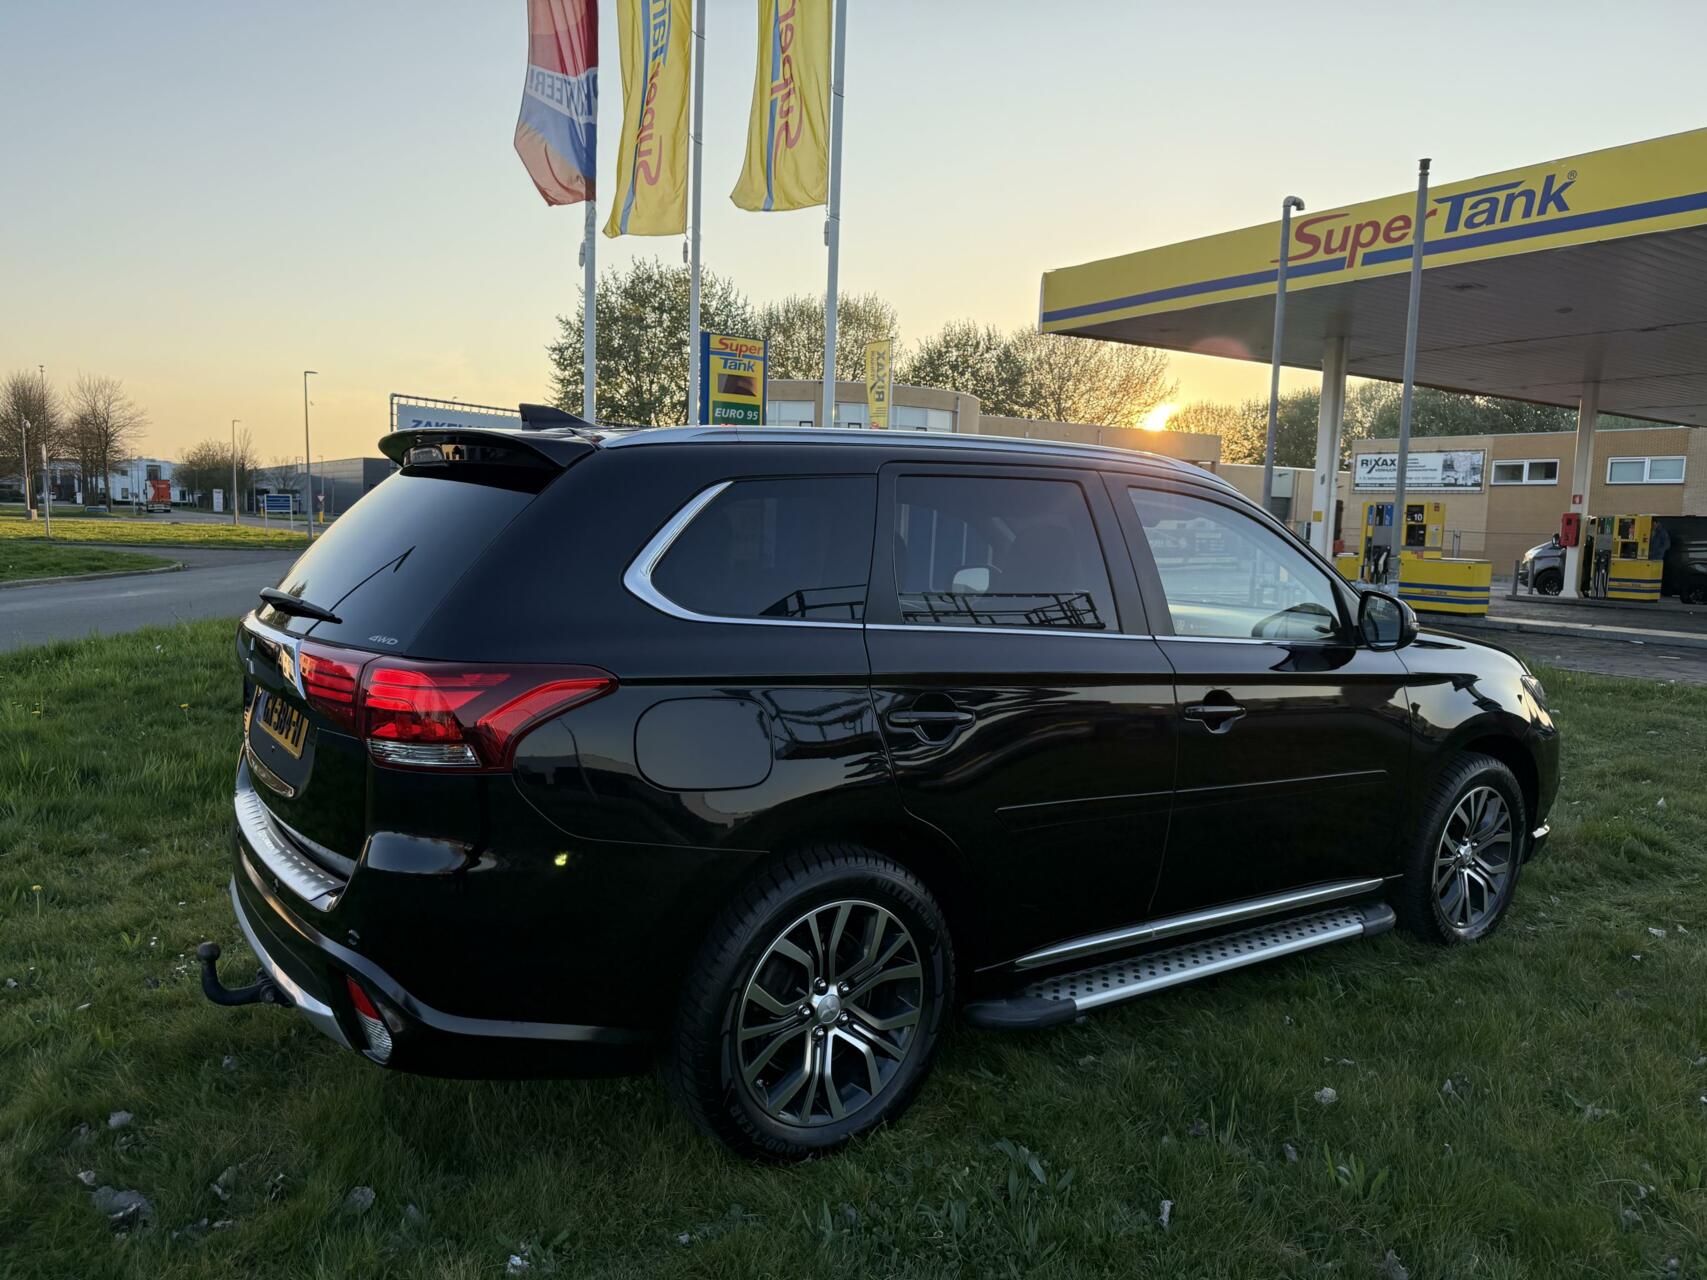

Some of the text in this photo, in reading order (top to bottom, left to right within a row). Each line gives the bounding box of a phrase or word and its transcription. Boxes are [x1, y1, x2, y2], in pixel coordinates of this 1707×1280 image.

[710, 336, 763, 358] Super
[720, 357, 756, 373] Tank
[714, 407, 759, 420] EURO 95
[1361, 457, 1397, 474] RIXAX
[1413, 513, 1423, 521] 10
[368, 634, 399, 645] 4WD
